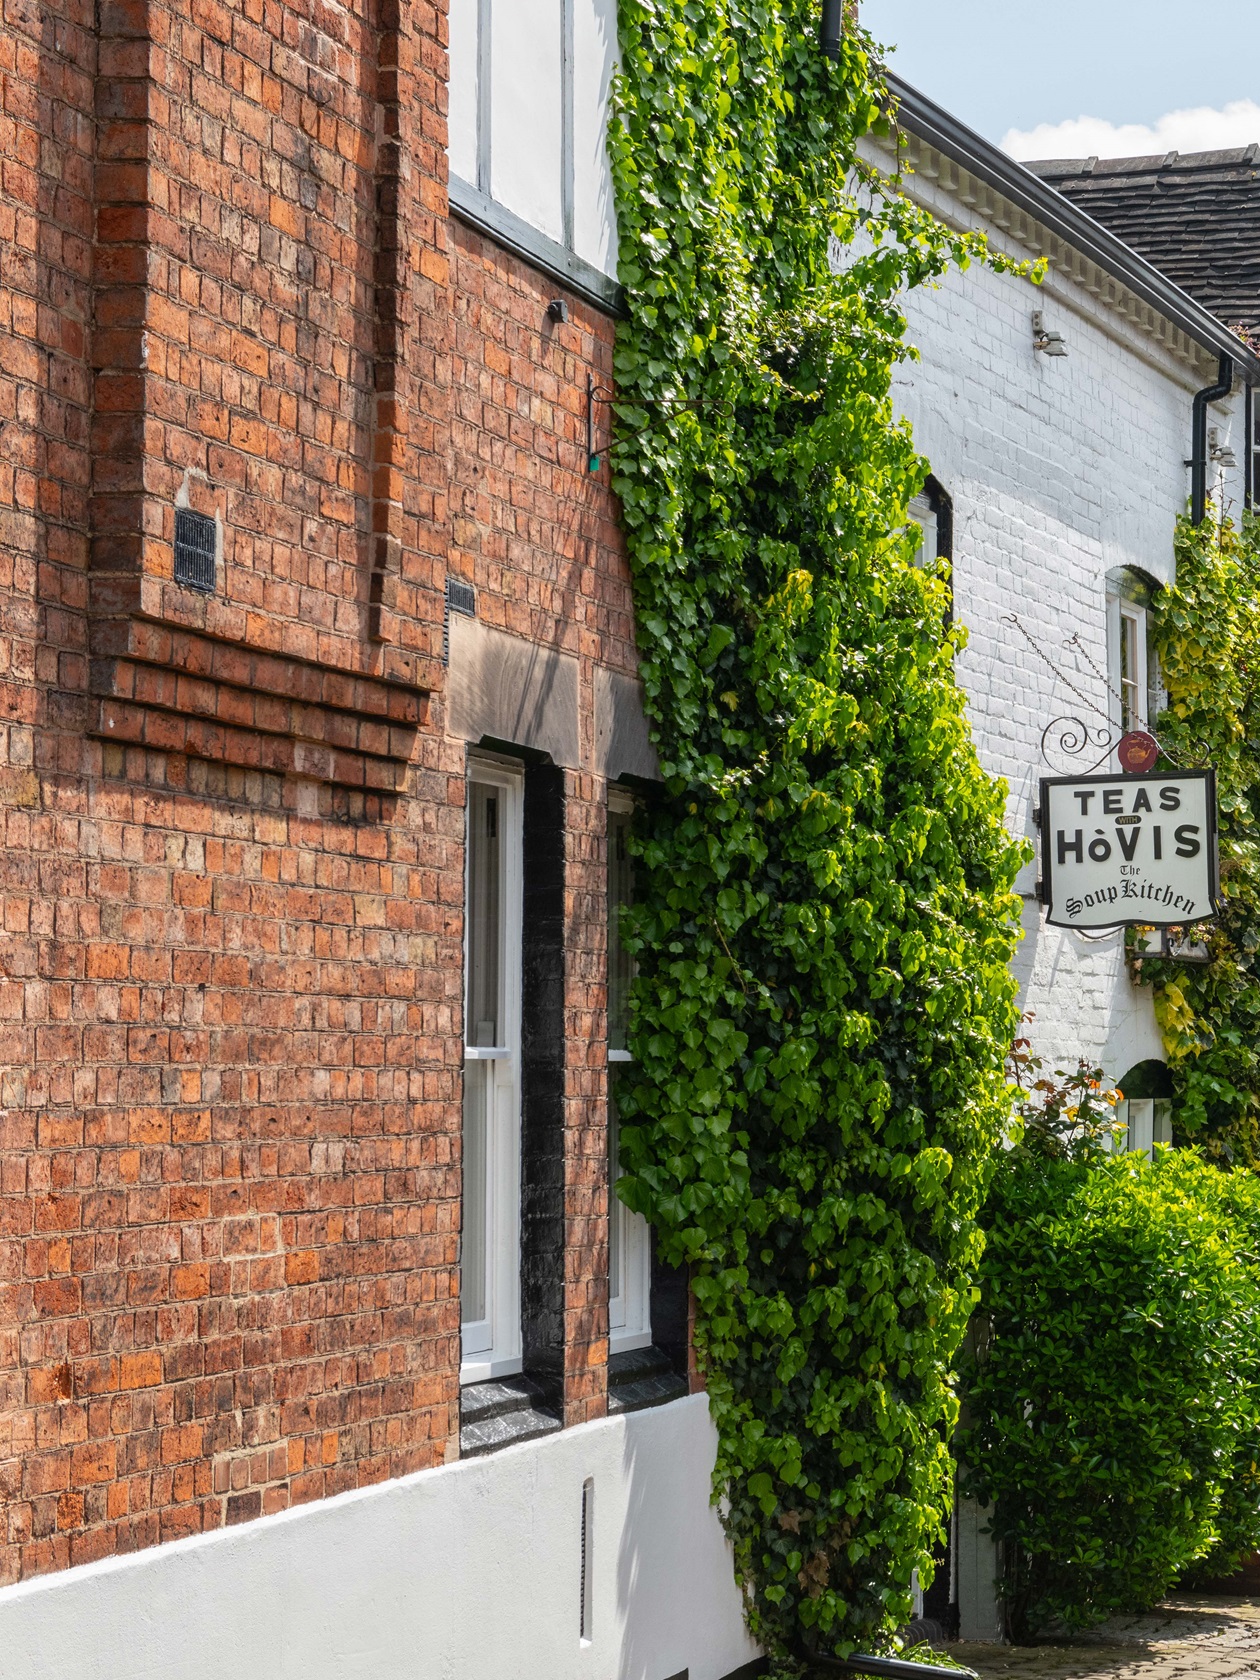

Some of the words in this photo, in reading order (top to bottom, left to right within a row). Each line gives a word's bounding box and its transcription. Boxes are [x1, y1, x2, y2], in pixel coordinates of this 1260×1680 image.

[1073, 786, 1181, 816] TEAS
[1118, 816, 1138, 824] WITH
[1119, 865, 1141, 876] The
[1065, 886, 1118, 919] Soup
[1119, 879, 1197, 915] Kitchen
